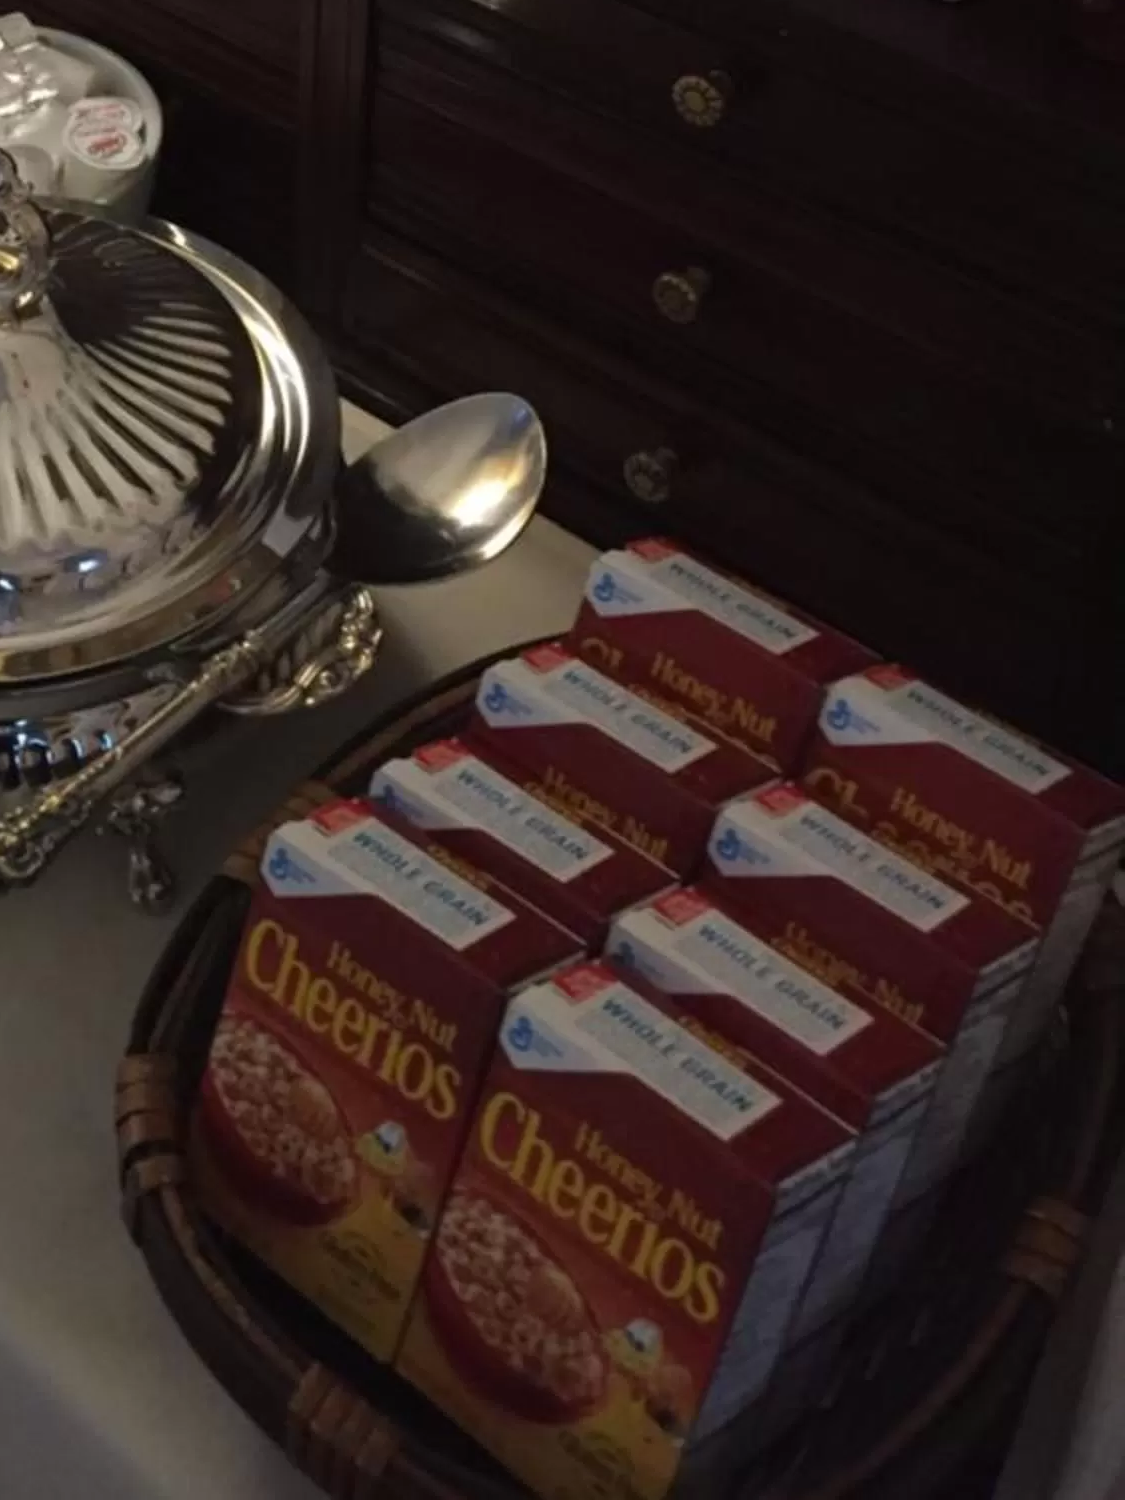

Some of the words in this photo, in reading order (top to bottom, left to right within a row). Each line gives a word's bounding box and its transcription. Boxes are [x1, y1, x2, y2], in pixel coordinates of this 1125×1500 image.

[353, 831, 423, 881] WHOLE
[423, 880, 490, 926] GRAIN
[890, 786, 976, 858] Honey
[977, 836, 1034, 891] Nut
[247, 917, 463, 1121] Cheerios
[326, 938, 407, 1022] Honey
[408, 999, 459, 1054] Nut
[699, 923, 769, 981] WHOLE
[777, 979, 848, 1032] GRAIN
[604, 999, 675, 1054] WHOLE
[678, 1055, 750, 1111] GRAIN
[480, 1090, 728, 1325] Cheerios
[576, 1120, 664, 1210] Honey
[666, 1187, 725, 1251] Nut
